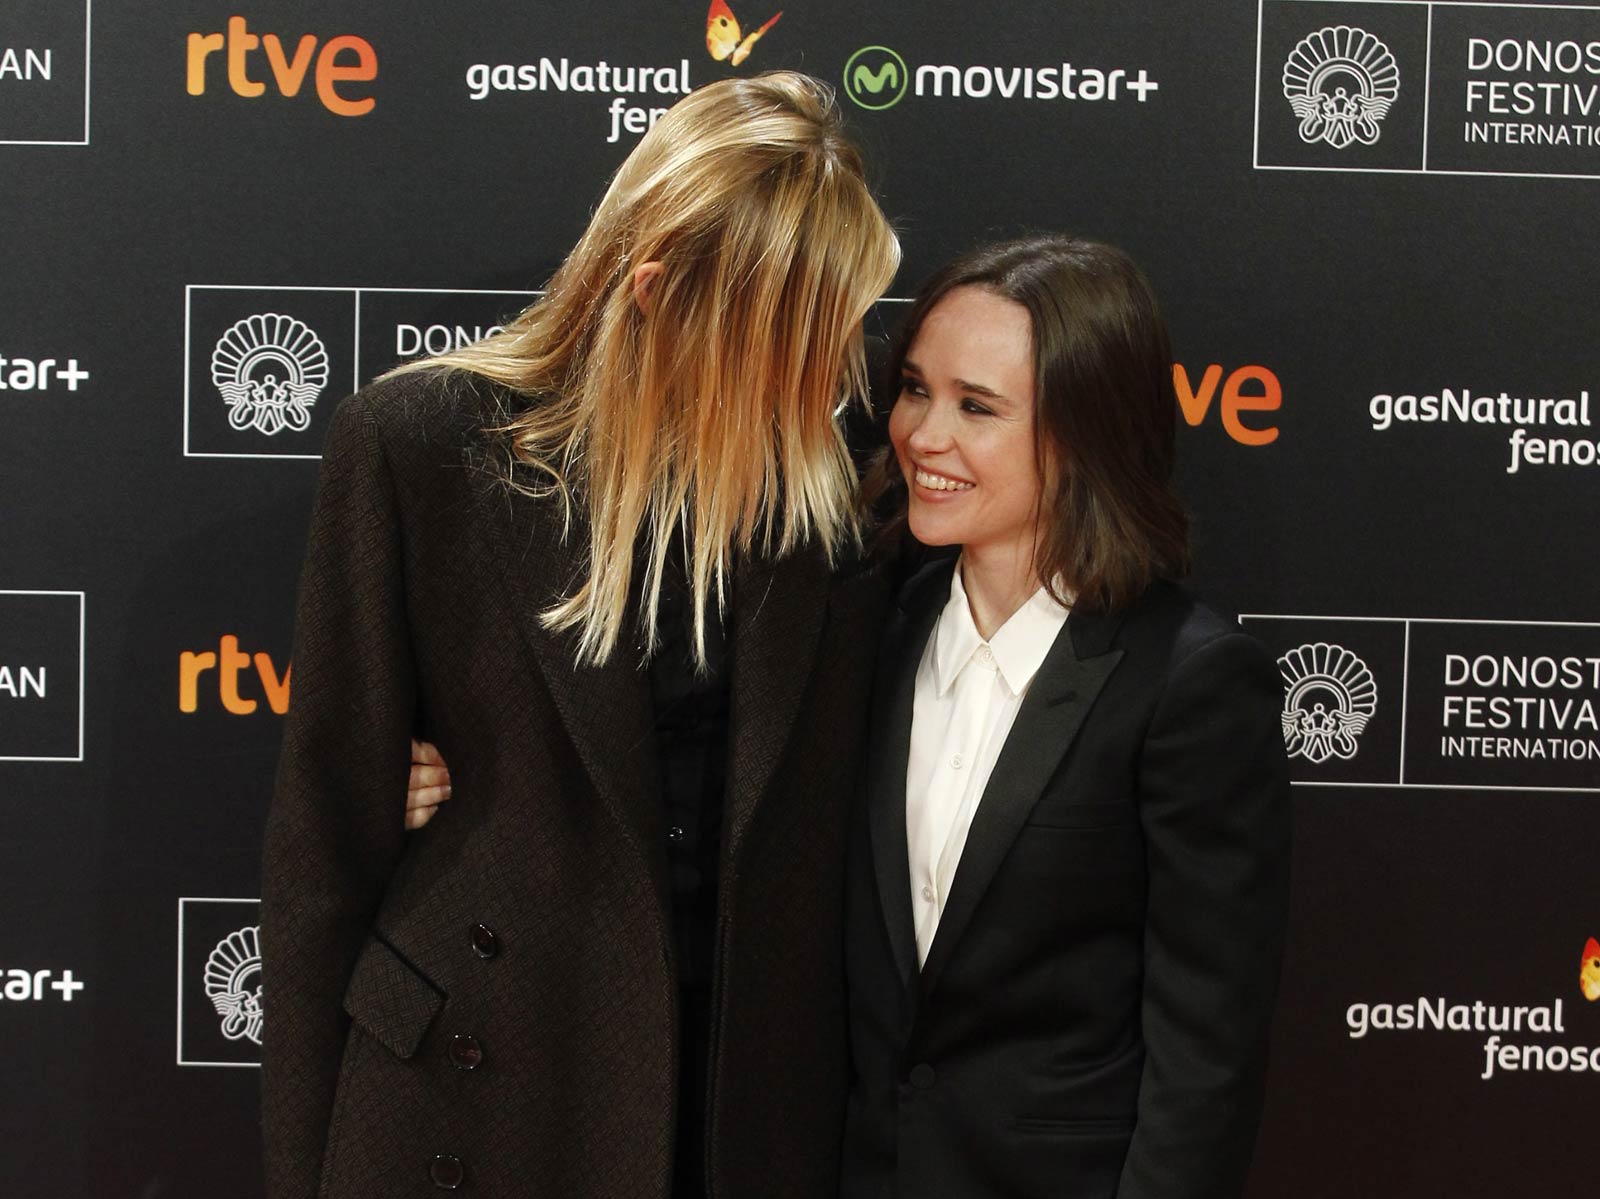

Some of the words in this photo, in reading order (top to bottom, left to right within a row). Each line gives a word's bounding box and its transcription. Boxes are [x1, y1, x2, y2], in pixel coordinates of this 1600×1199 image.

[0, 47, 52, 81] AN
[186, 15, 379, 117] rtve
[1467, 37, 1600, 75] DONOS
[465, 57, 693, 101] gasNatural
[915, 62, 1159, 103] movistar+
[1466, 80, 1600, 117] FESTIV
[1172, 363, 1283, 446] ve
[1369, 388, 1591, 432] gasNatural
[1506, 427, 1600, 474] feno
[0, 665, 46, 698] AN
[179, 634, 293, 716] rtv
[1444, 654, 1600, 690] DONOST
[1443, 695, 1599, 731] FESTIVA
[1441, 736, 1600, 760] INTERNATION
[0, 968, 85, 1002] ar+
[1346, 996, 1565, 1040] gasNatural
